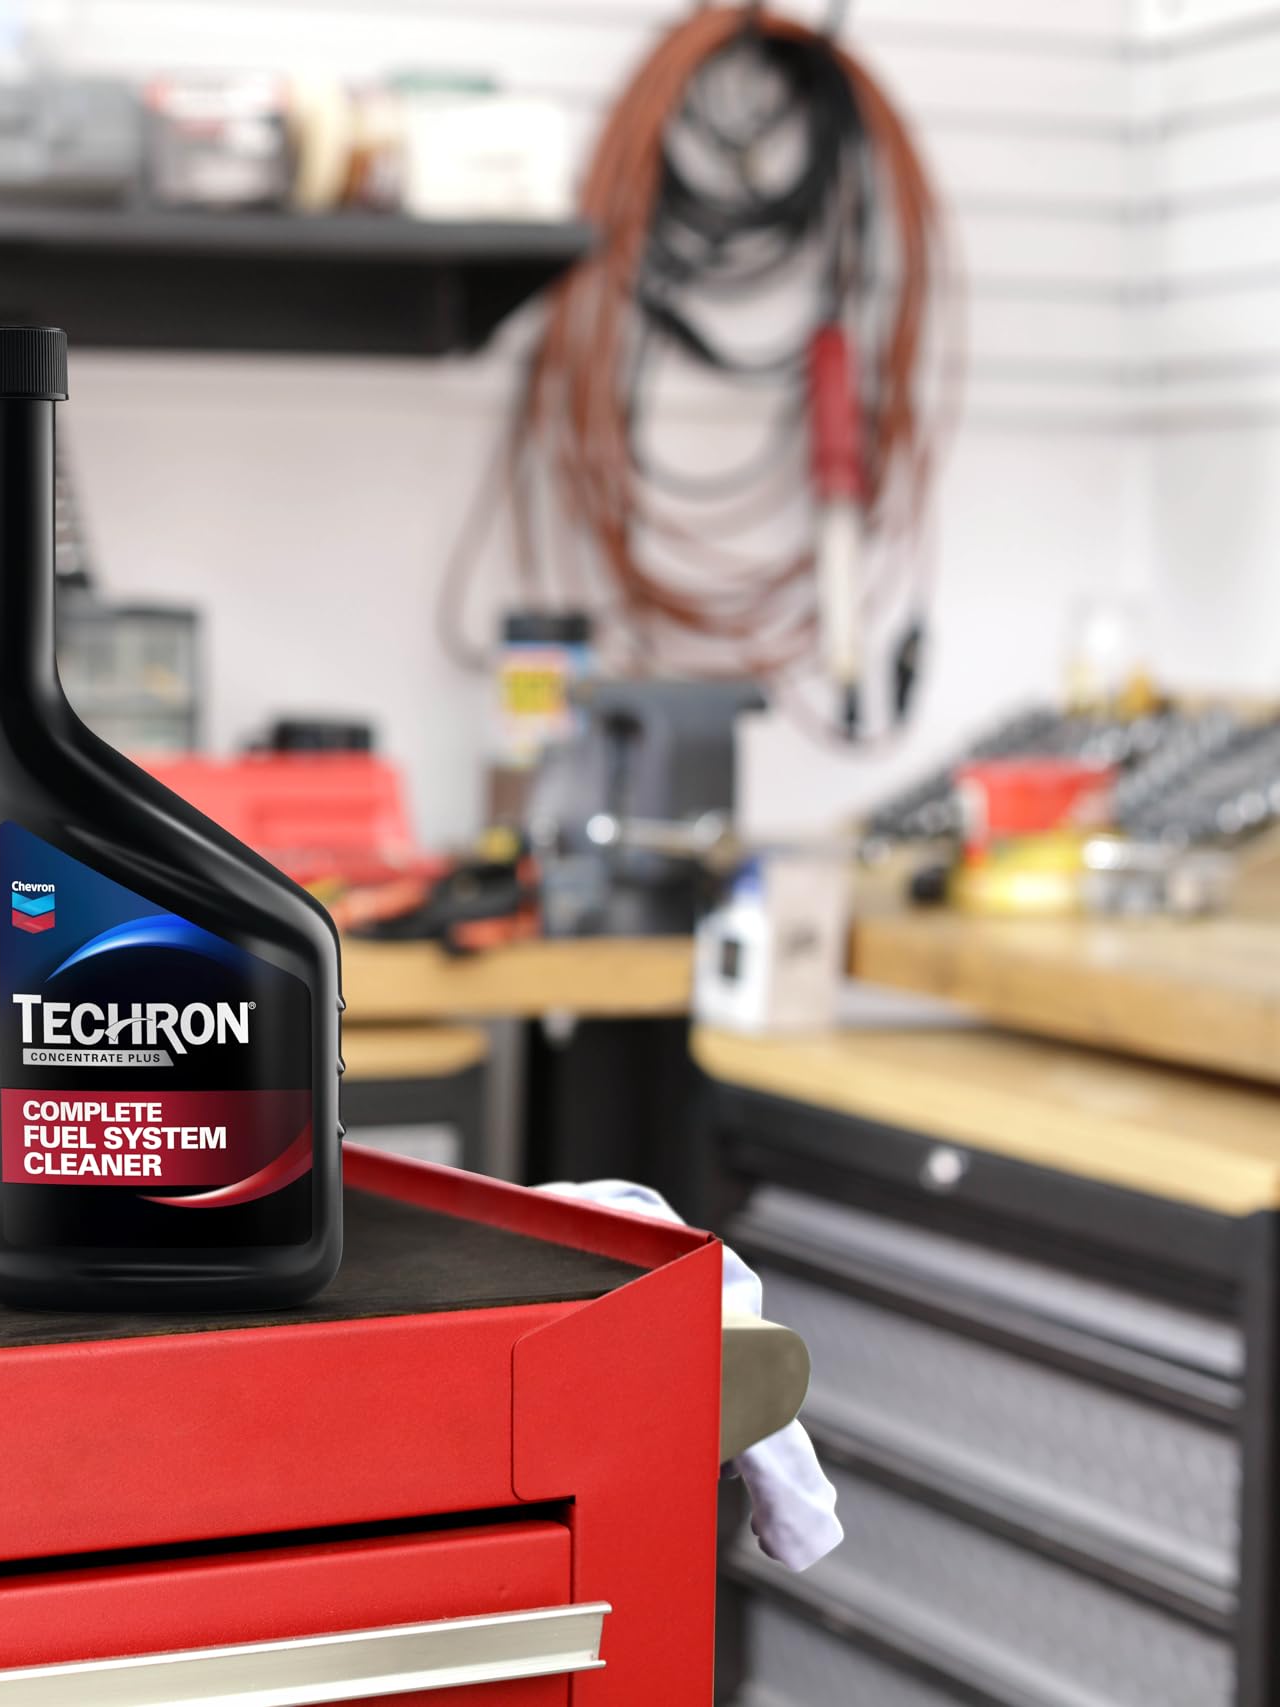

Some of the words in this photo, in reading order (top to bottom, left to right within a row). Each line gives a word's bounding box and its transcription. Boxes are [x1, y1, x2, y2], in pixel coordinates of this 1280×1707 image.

[12, 881, 55, 893] Chevron
[30, 1052, 124, 1063] CONCENTRATE
[128, 1053, 161, 1063] PLUS
[23, 1101, 162, 1123] COMPLETE
[23, 1126, 96, 1149] FUEL
[104, 1126, 227, 1150] SYSTEM
[23, 1153, 162, 1177] CLEANER
